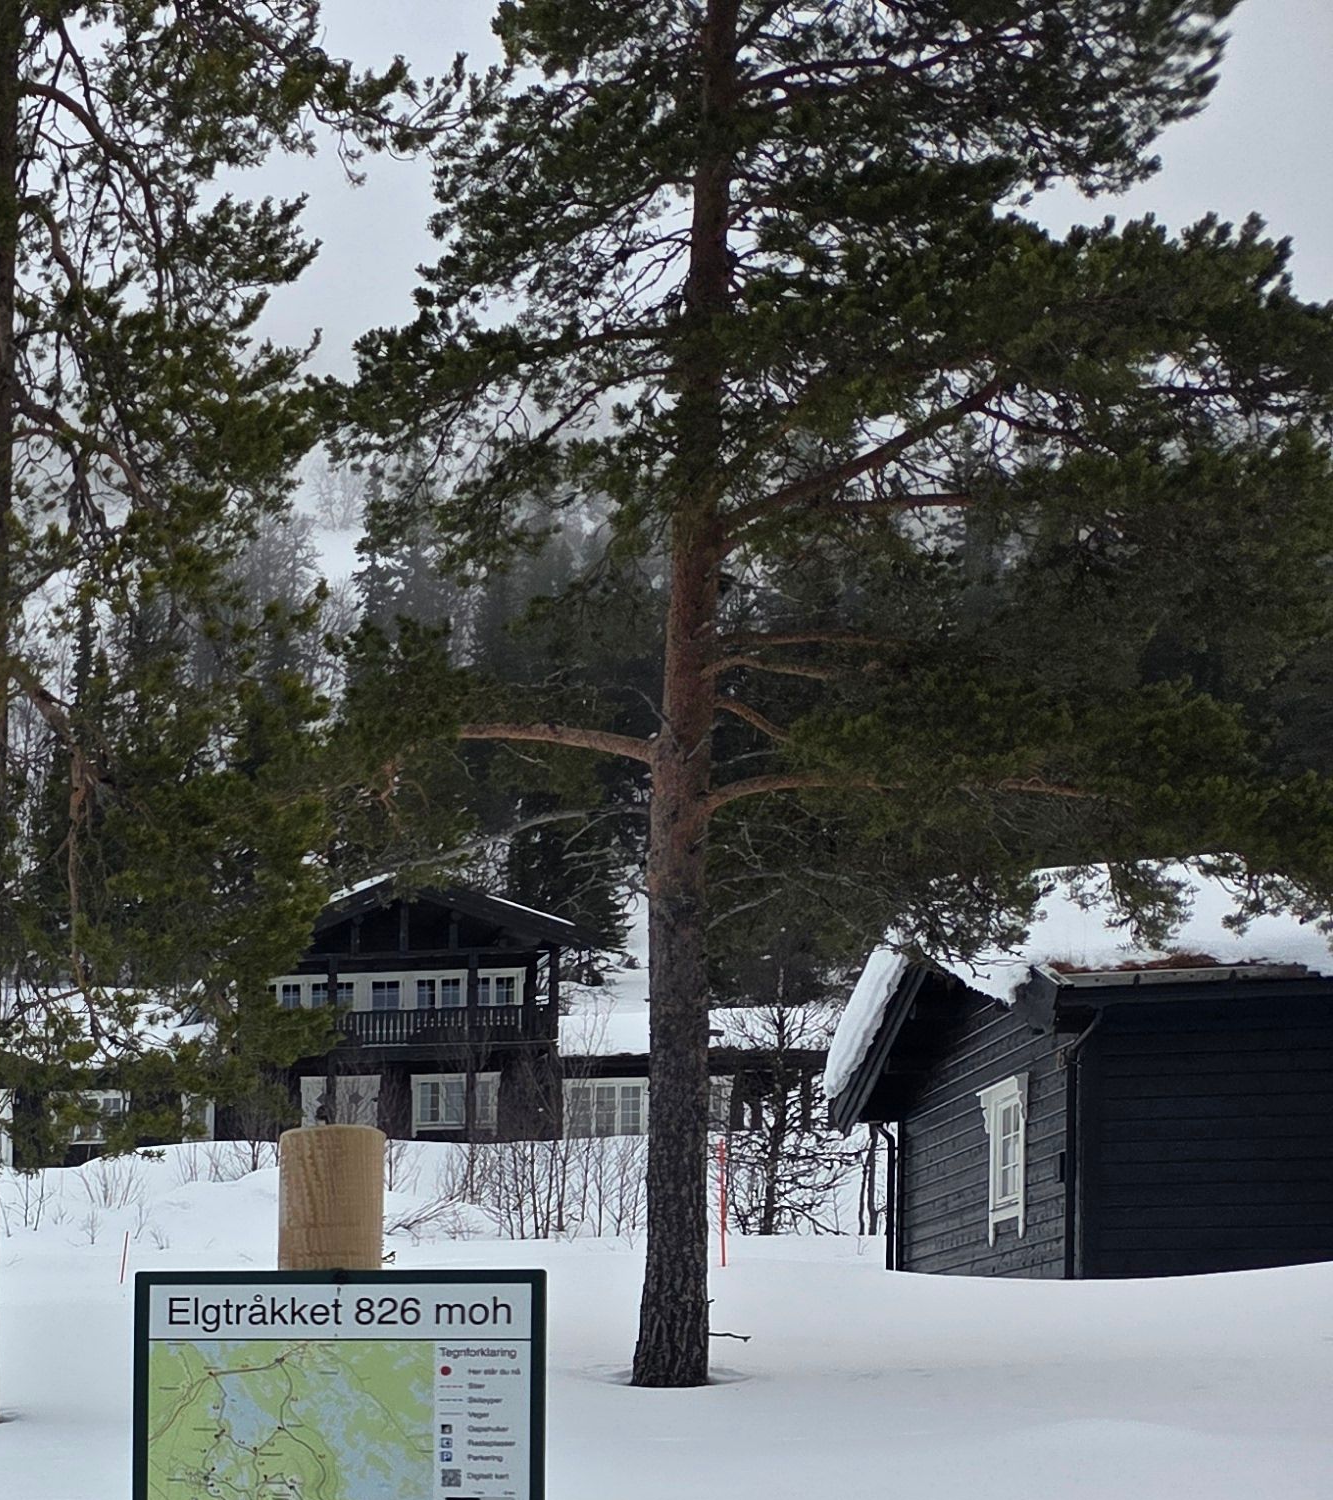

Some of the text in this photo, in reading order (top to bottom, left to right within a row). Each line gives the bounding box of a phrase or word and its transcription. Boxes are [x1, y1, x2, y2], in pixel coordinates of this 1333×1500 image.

[168, 1294, 512, 1333] Elgtråkket 826 moh
[438, 1346, 517, 1360] Tegnforklaring
